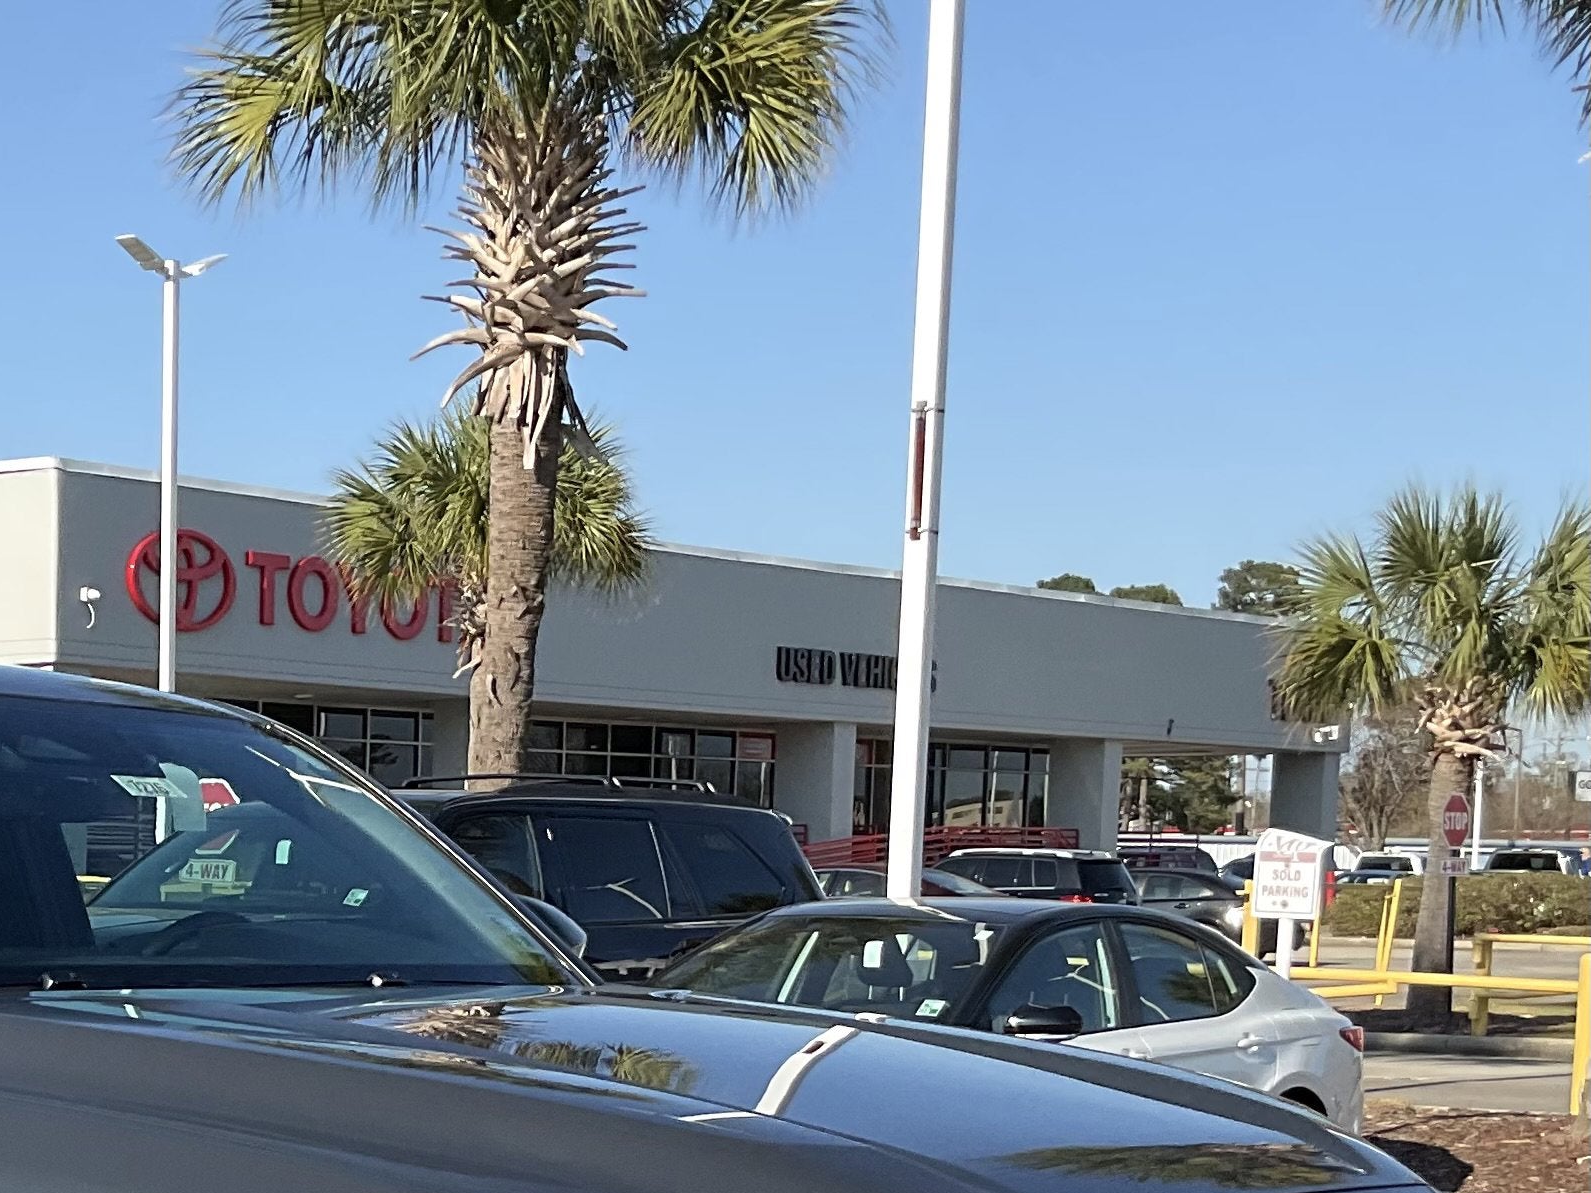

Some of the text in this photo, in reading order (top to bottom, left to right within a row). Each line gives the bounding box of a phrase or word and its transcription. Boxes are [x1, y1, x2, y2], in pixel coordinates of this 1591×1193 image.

[245, 550, 470, 645] TOYOT
[776, 645, 837, 685] USED
[1444, 811, 1468, 831] STOP
[185, 862, 230, 880] 4-WAY
[1272, 868, 1302, 882] SOLD
[1261, 884, 1309, 898] PARKING
